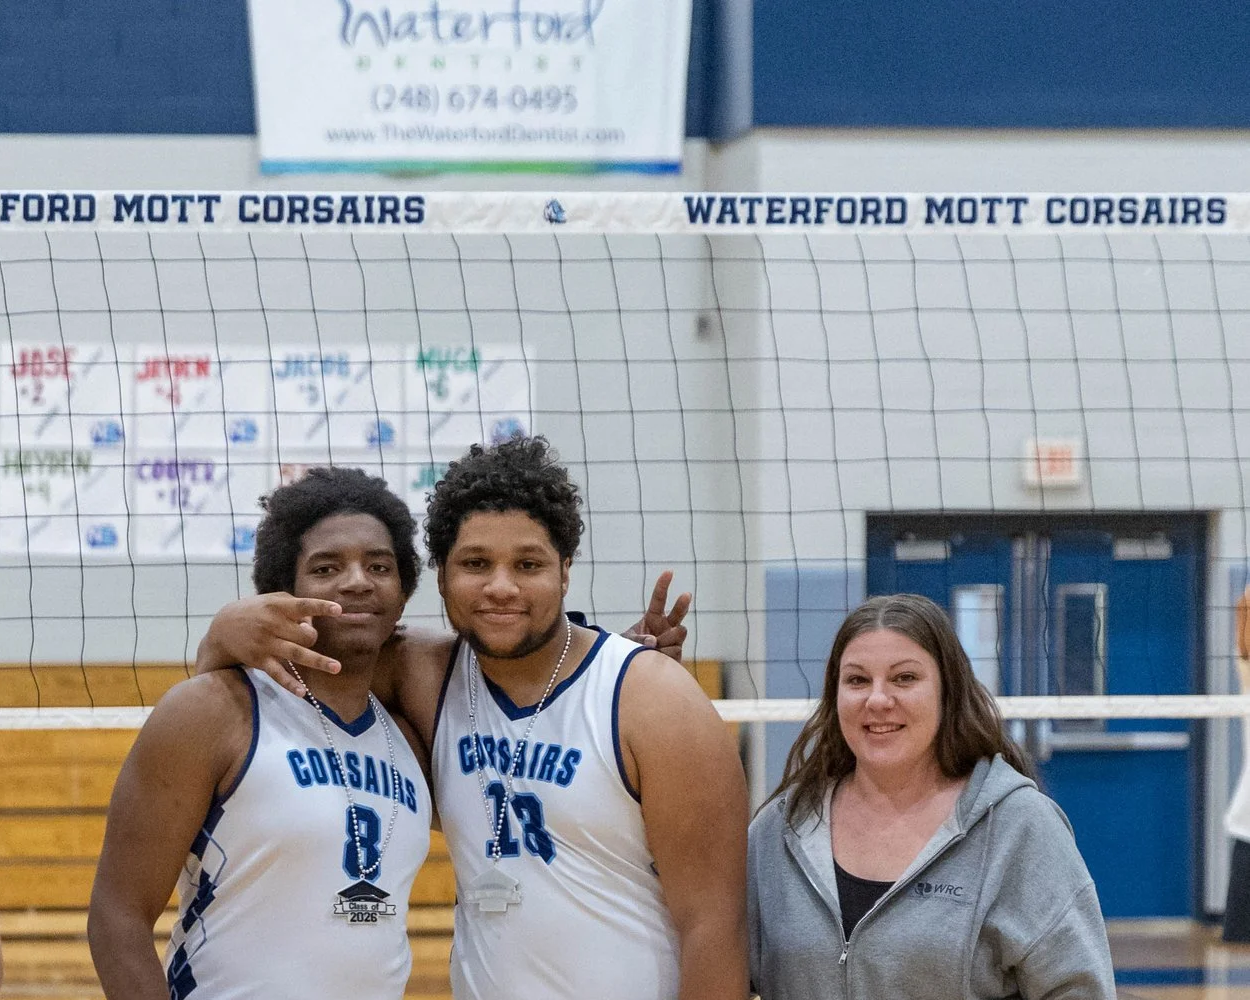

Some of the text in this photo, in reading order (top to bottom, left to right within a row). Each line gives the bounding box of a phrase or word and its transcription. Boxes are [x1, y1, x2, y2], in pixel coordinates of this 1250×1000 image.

[337, 0, 603, 48] Waterford
[371, 83, 440, 115] (248)
[113, 194, 221, 223] MOTT
[238, 194, 426, 224] CORSAIRS
[684, 196, 1226, 225] WATERFORD MOTT CORSAIRS
[458, 732, 583, 788] CORSAIRS
[286, 747, 418, 815] CORSAIRS
[341, 803, 382, 884] 8
[934, 883, 964, 897] WRC
[348, 902, 379, 911] Class of
[350, 911, 378, 923] 2026
